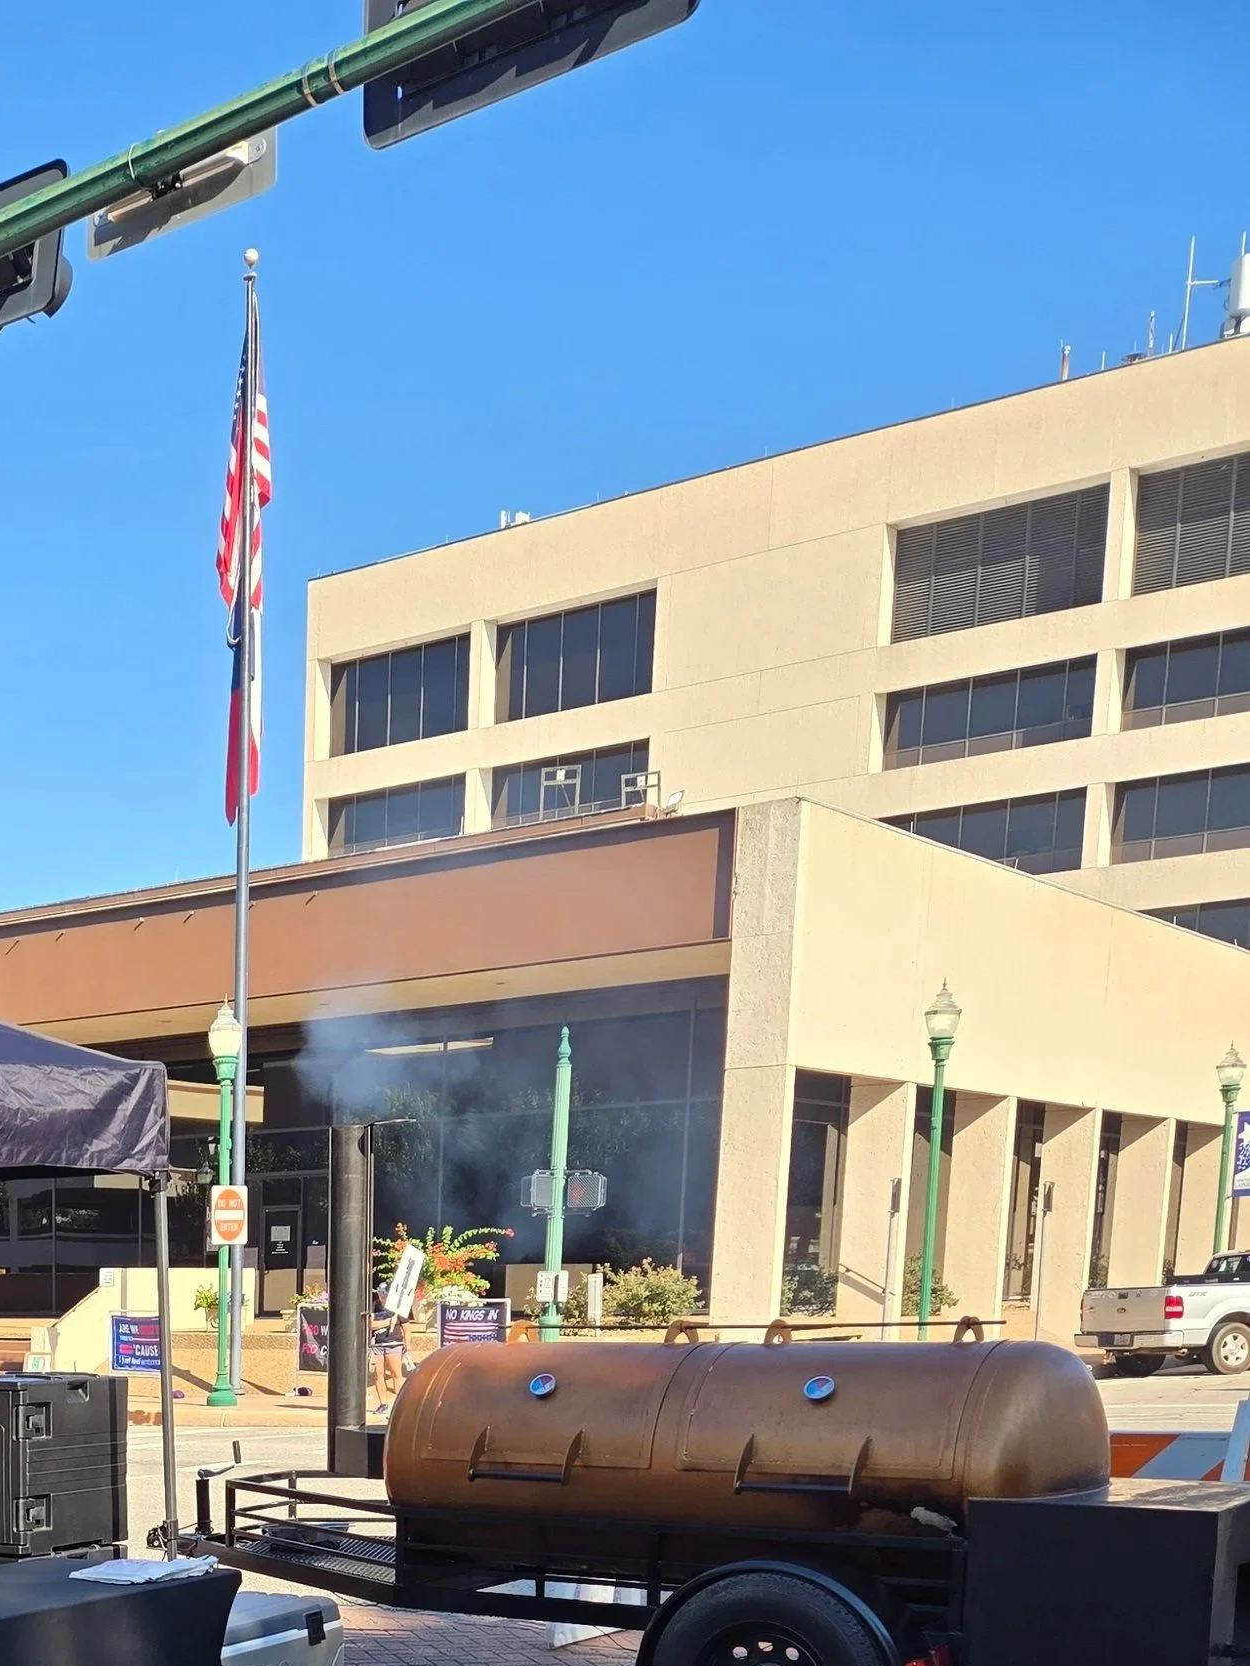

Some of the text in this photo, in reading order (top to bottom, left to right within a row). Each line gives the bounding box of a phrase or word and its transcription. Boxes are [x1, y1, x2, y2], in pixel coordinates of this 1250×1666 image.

[220, 1222, 239, 1232] ENTER
[445, 1309, 499, 1320] NO KINGS IN
[133, 1344, 158, 1357] 'CAUSE
